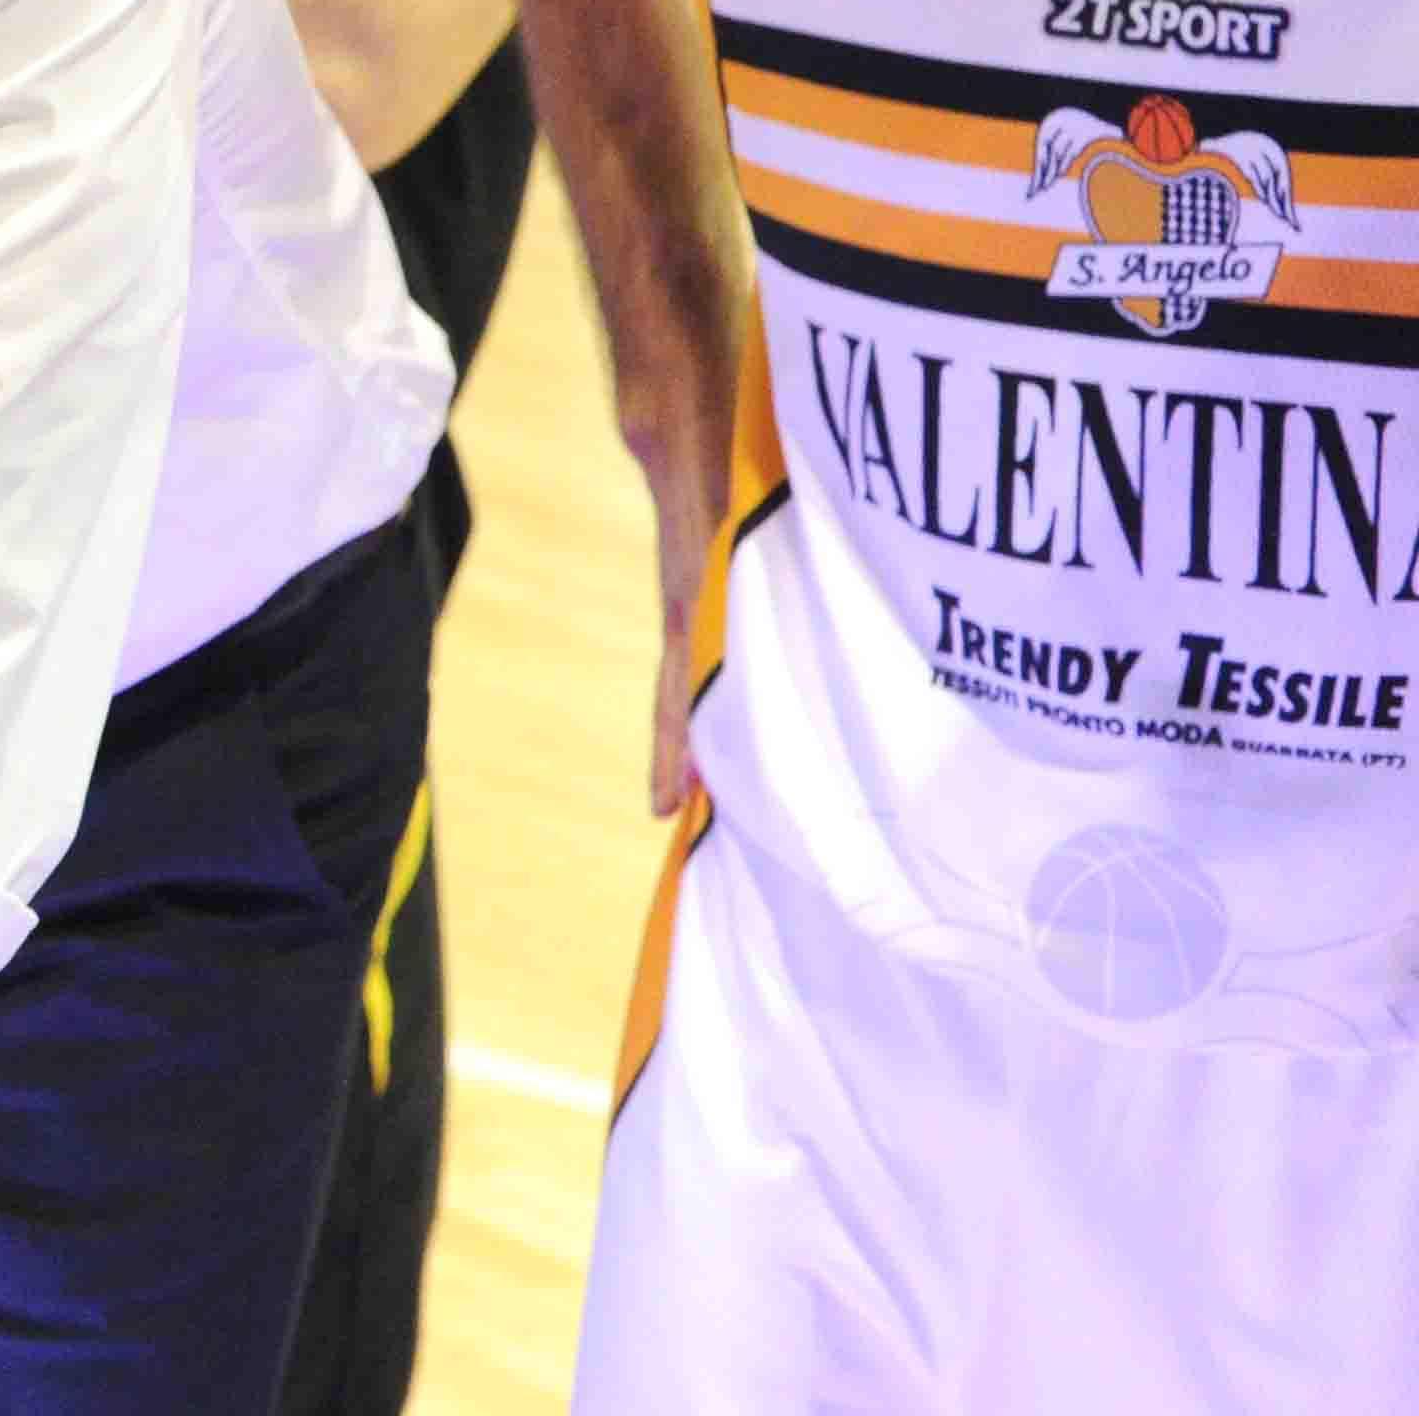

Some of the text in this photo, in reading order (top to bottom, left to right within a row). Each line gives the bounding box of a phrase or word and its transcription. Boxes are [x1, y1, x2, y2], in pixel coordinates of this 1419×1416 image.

[1069, 245, 1253, 295] S. Angelo
[805, 320, 1419, 607] VALENTIN
[930, 665, 1020, 709] TESSUTI
[1026, 695, 1125, 737] PRONTO
[1136, 719, 1224, 751] MODA
[932, 585, 1410, 731] TRENDY TESSILE
